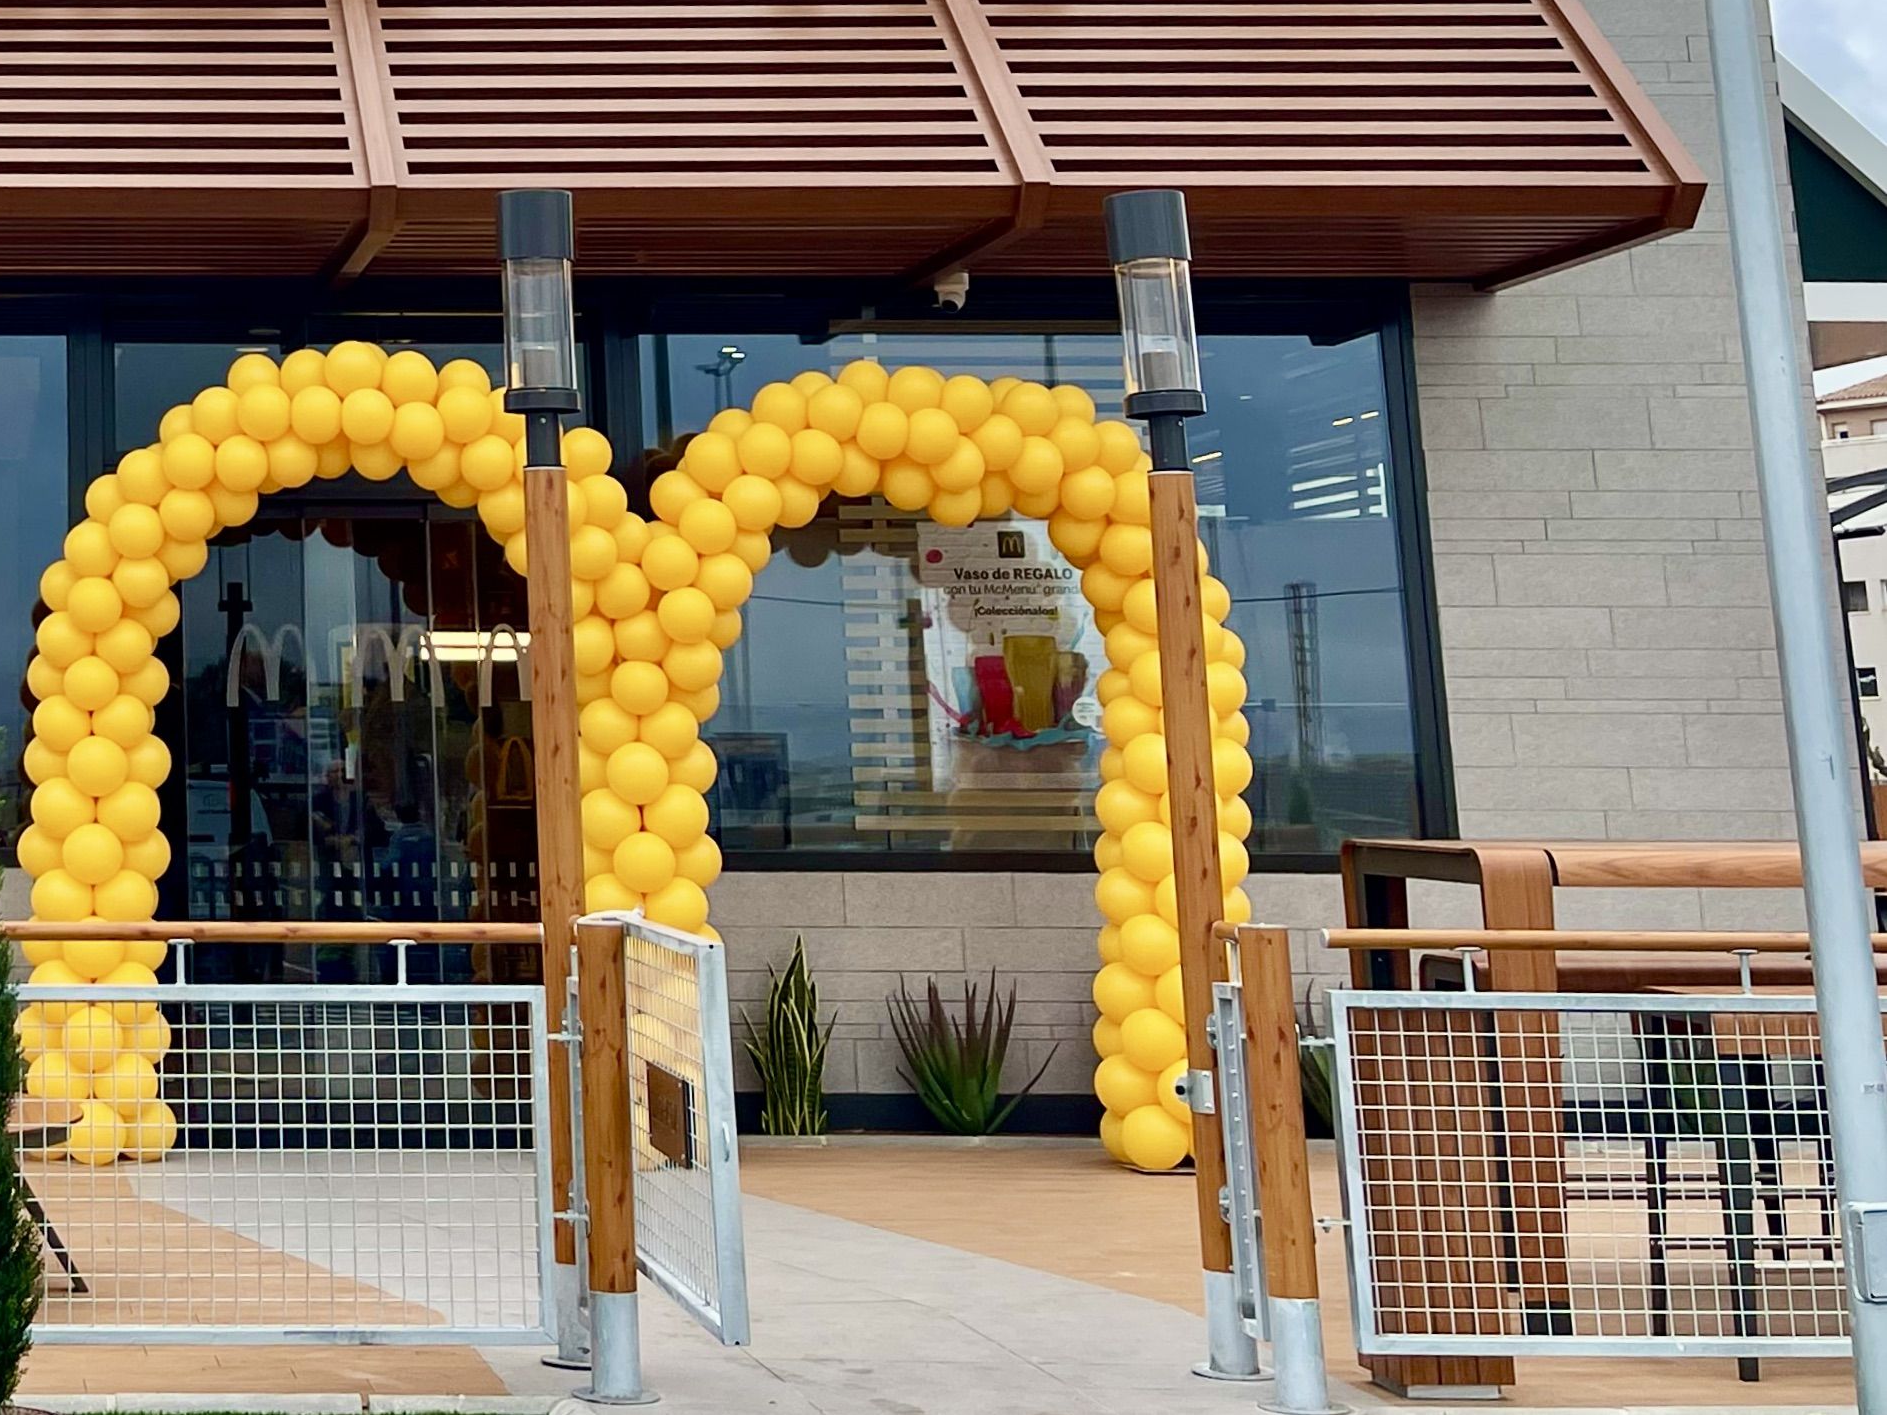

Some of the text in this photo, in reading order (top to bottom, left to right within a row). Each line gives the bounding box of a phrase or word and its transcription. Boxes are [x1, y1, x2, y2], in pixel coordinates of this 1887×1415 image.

[954, 567, 1073, 580] Vaso de REGALO
[944, 586, 966, 595] con
[968, 584, 981, 595] tu
